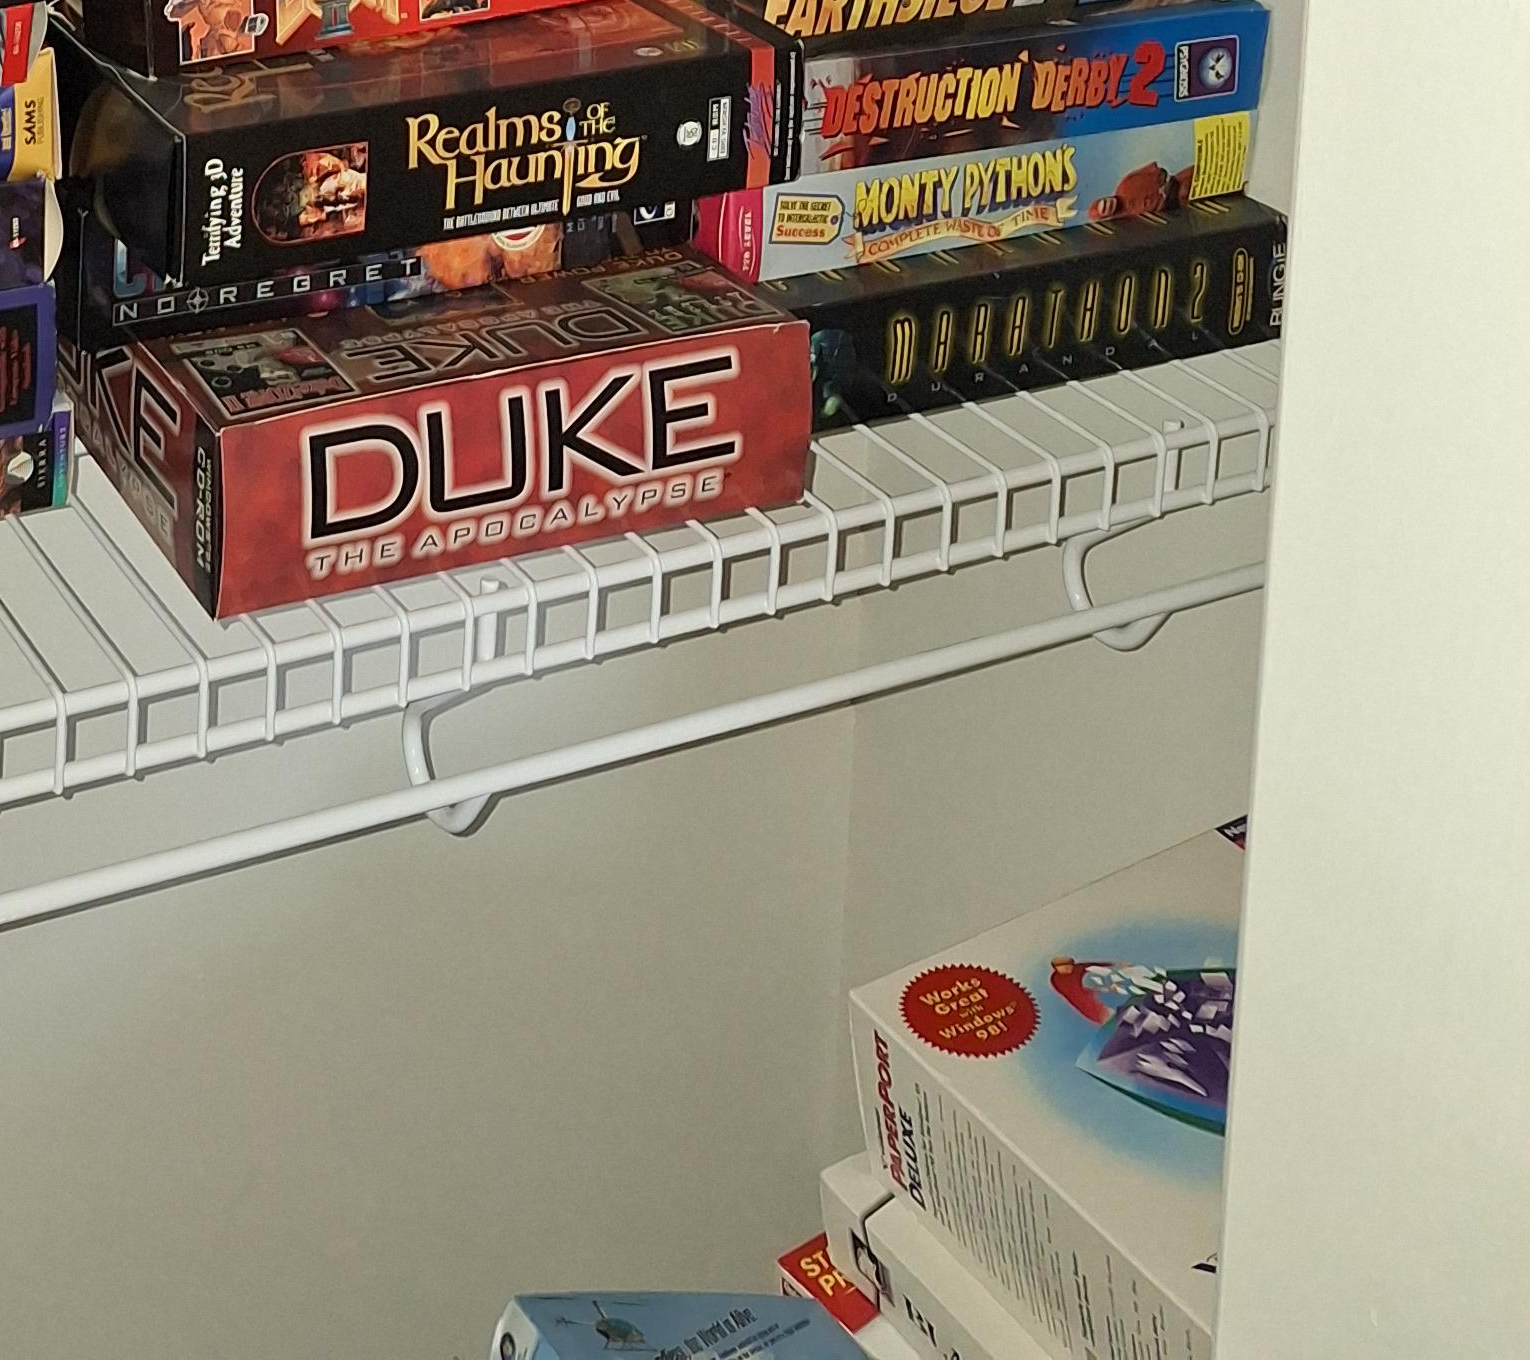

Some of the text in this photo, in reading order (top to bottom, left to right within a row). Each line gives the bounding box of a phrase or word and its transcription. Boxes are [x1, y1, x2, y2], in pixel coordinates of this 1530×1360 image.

[819, 39, 1169, 140] DESTRUCTION DERBY 2
[405, 106, 564, 170] Realms
[441, 130, 642, 213] Haunting
[854, 145, 1078, 230] MONTY PYTHON'S
[301, 350, 738, 541] DUKE
[306, 473, 724, 578] THE APOCALYPSE
[918, 976, 984, 1011] Works
[932, 986, 991, 1018] Great
